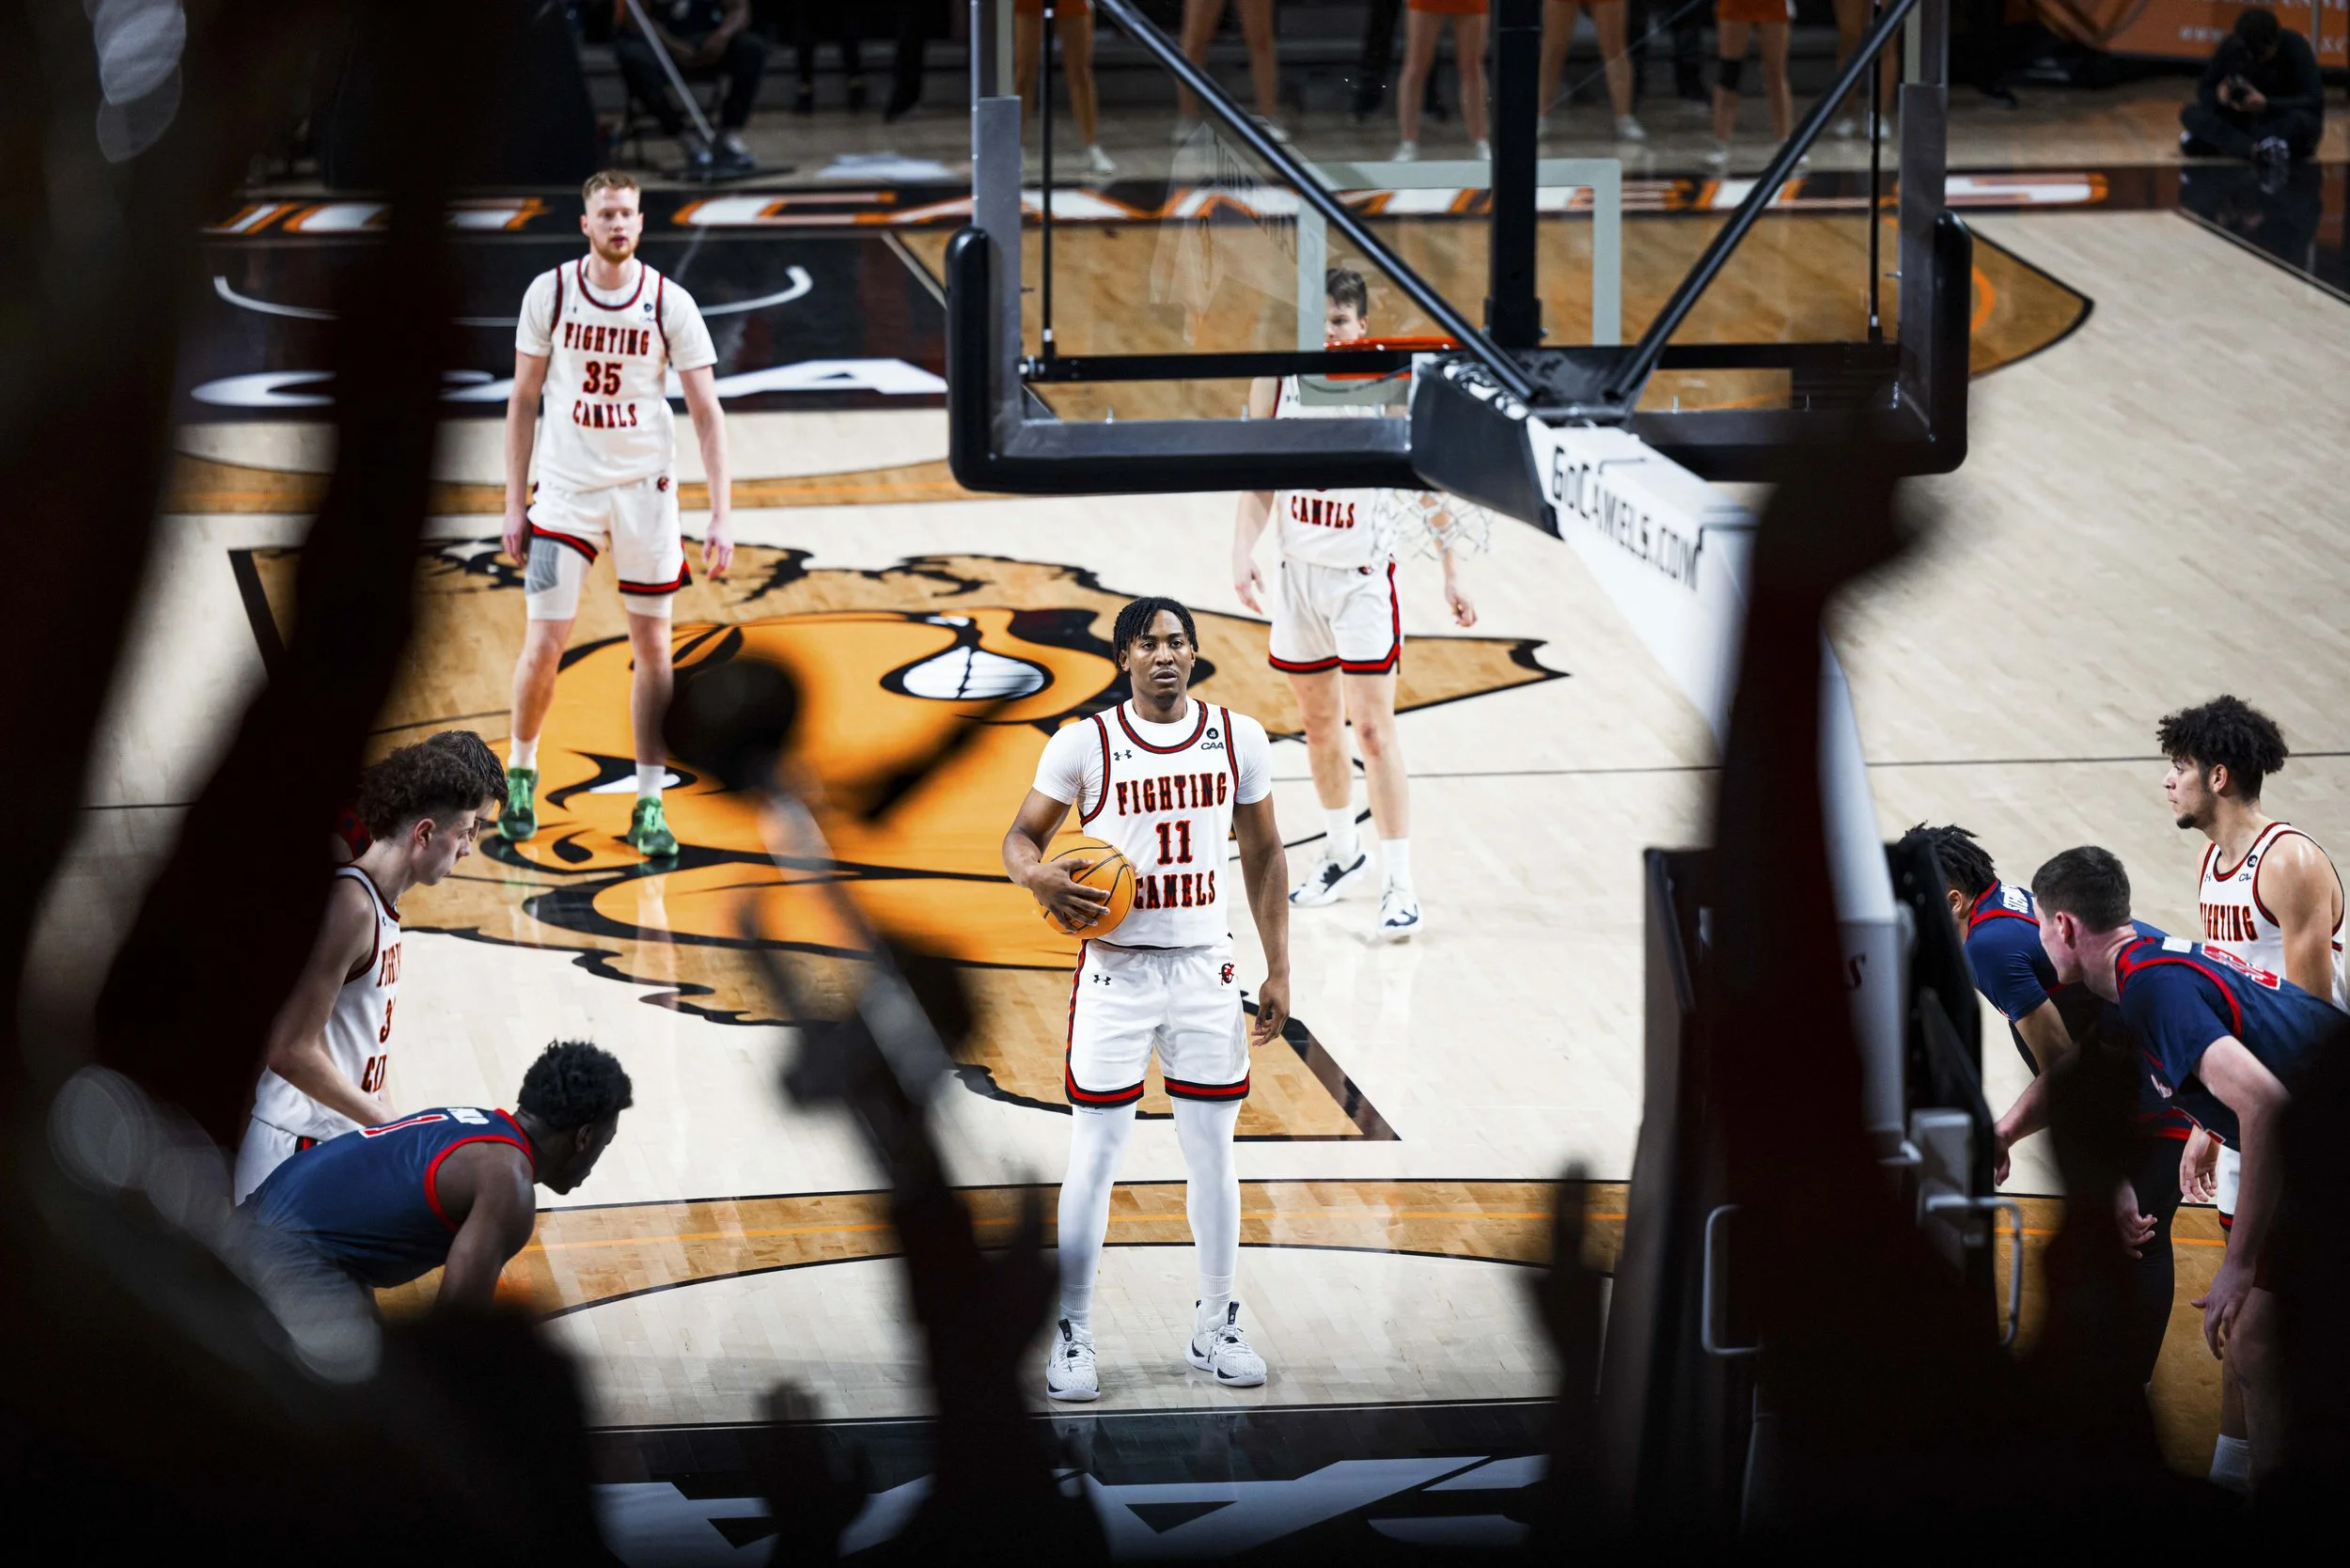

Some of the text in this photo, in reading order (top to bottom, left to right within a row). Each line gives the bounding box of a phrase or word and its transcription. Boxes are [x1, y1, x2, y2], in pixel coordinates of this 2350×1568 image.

[564, 321, 650, 356] FIGHTING
[583, 361, 622, 396] 35
[572, 400, 637, 429] CAMELS
[1292, 494, 1355, 528] CAMELS
[1200, 742, 1225, 750] CAA
[1116, 772, 1228, 816] FIGHTING
[1155, 820, 1193, 866] 11
[1134, 870, 1215, 910] CAMELS
